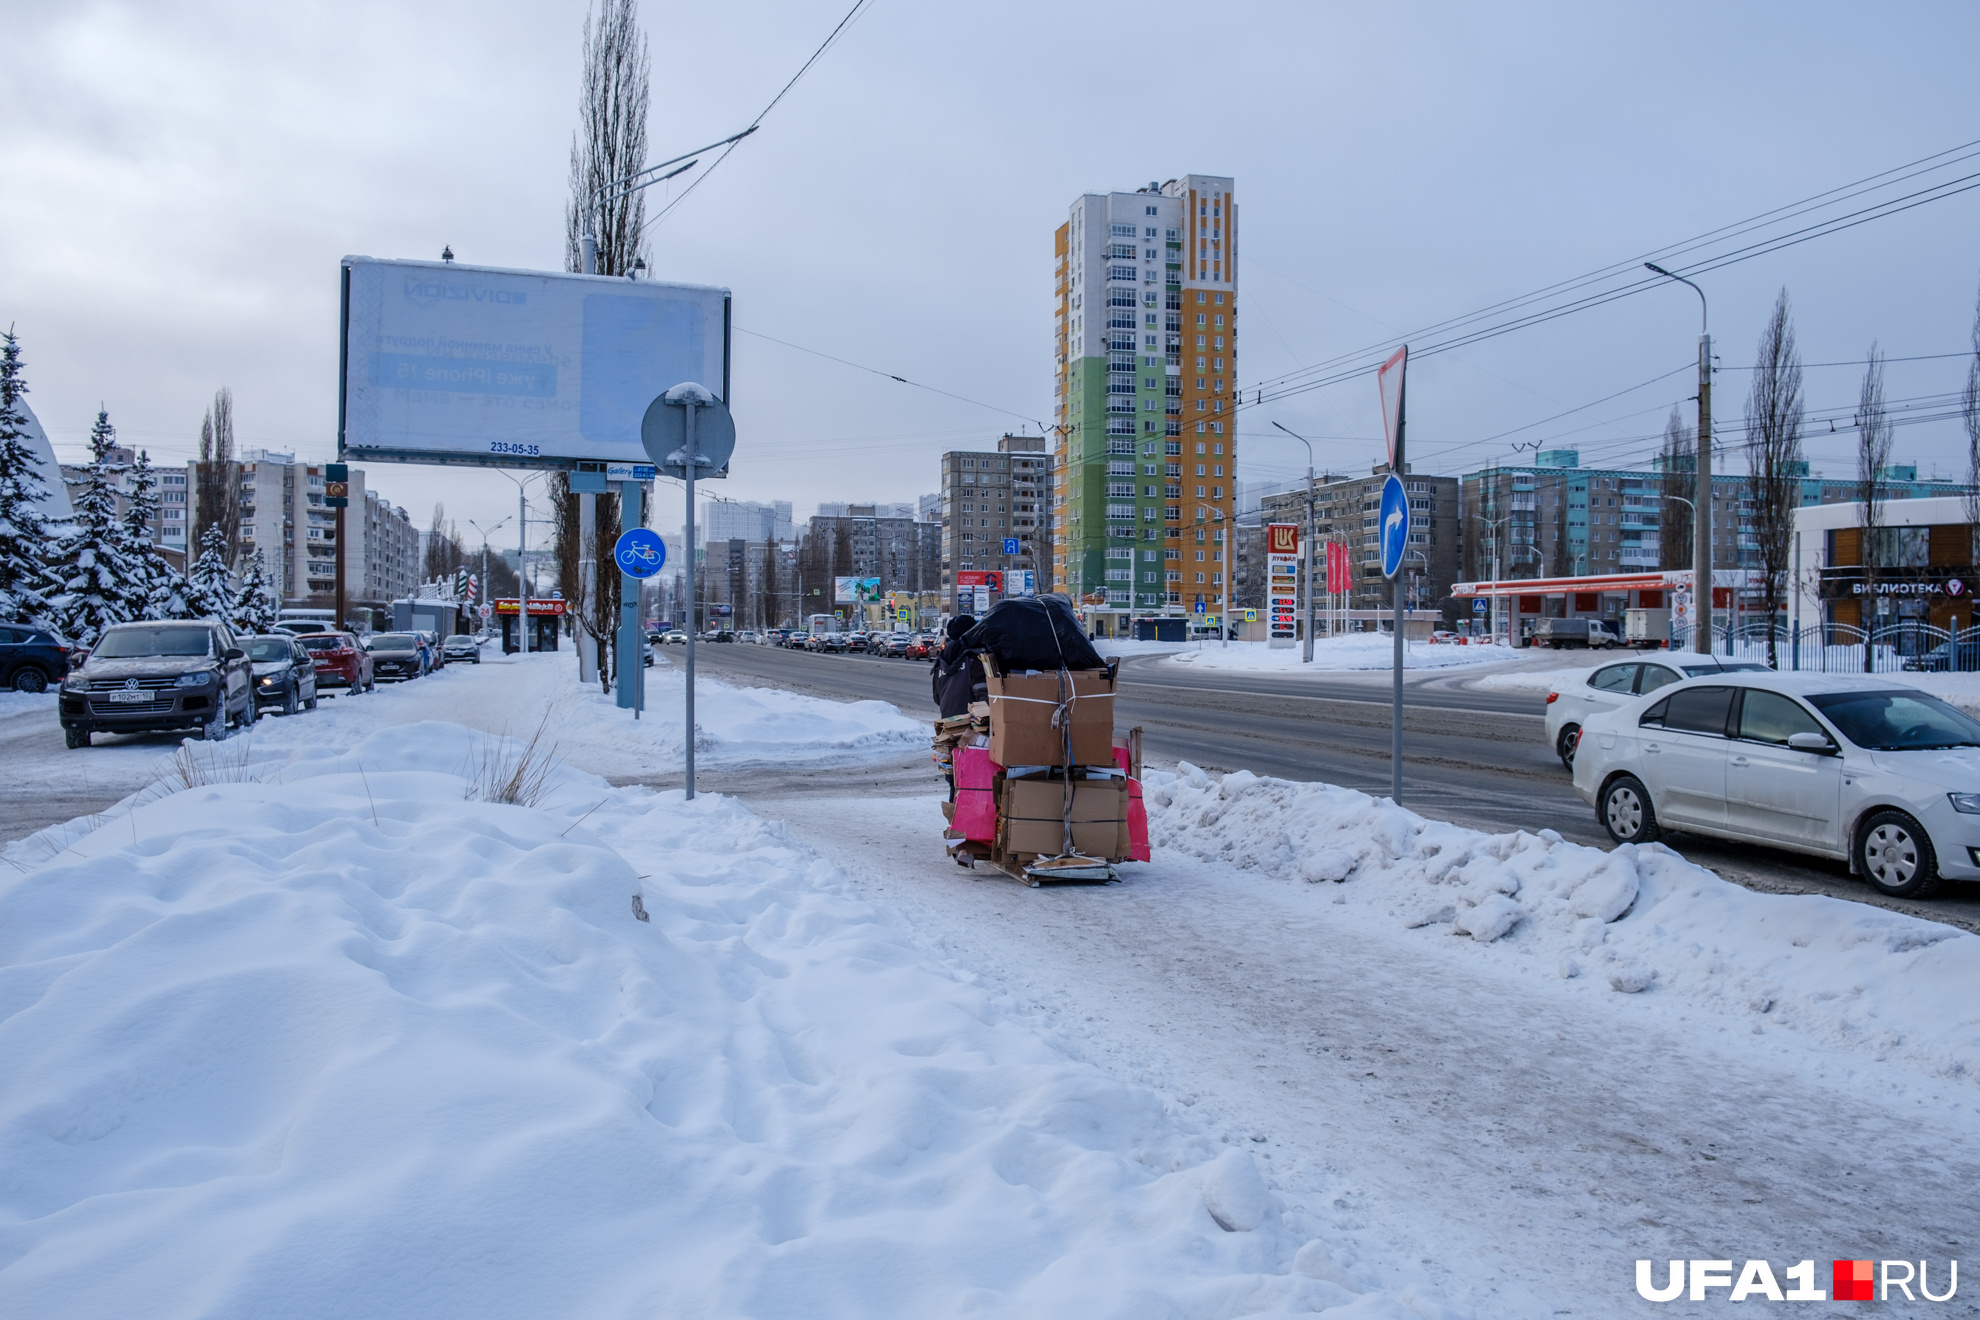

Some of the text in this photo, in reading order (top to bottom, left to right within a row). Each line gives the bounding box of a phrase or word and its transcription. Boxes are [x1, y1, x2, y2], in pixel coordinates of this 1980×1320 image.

[490, 442, 540, 455] 233-05-35
[607, 466, 633, 477] Gallery
[1852, 583, 1944, 594] БИБЛИОТЕКА
